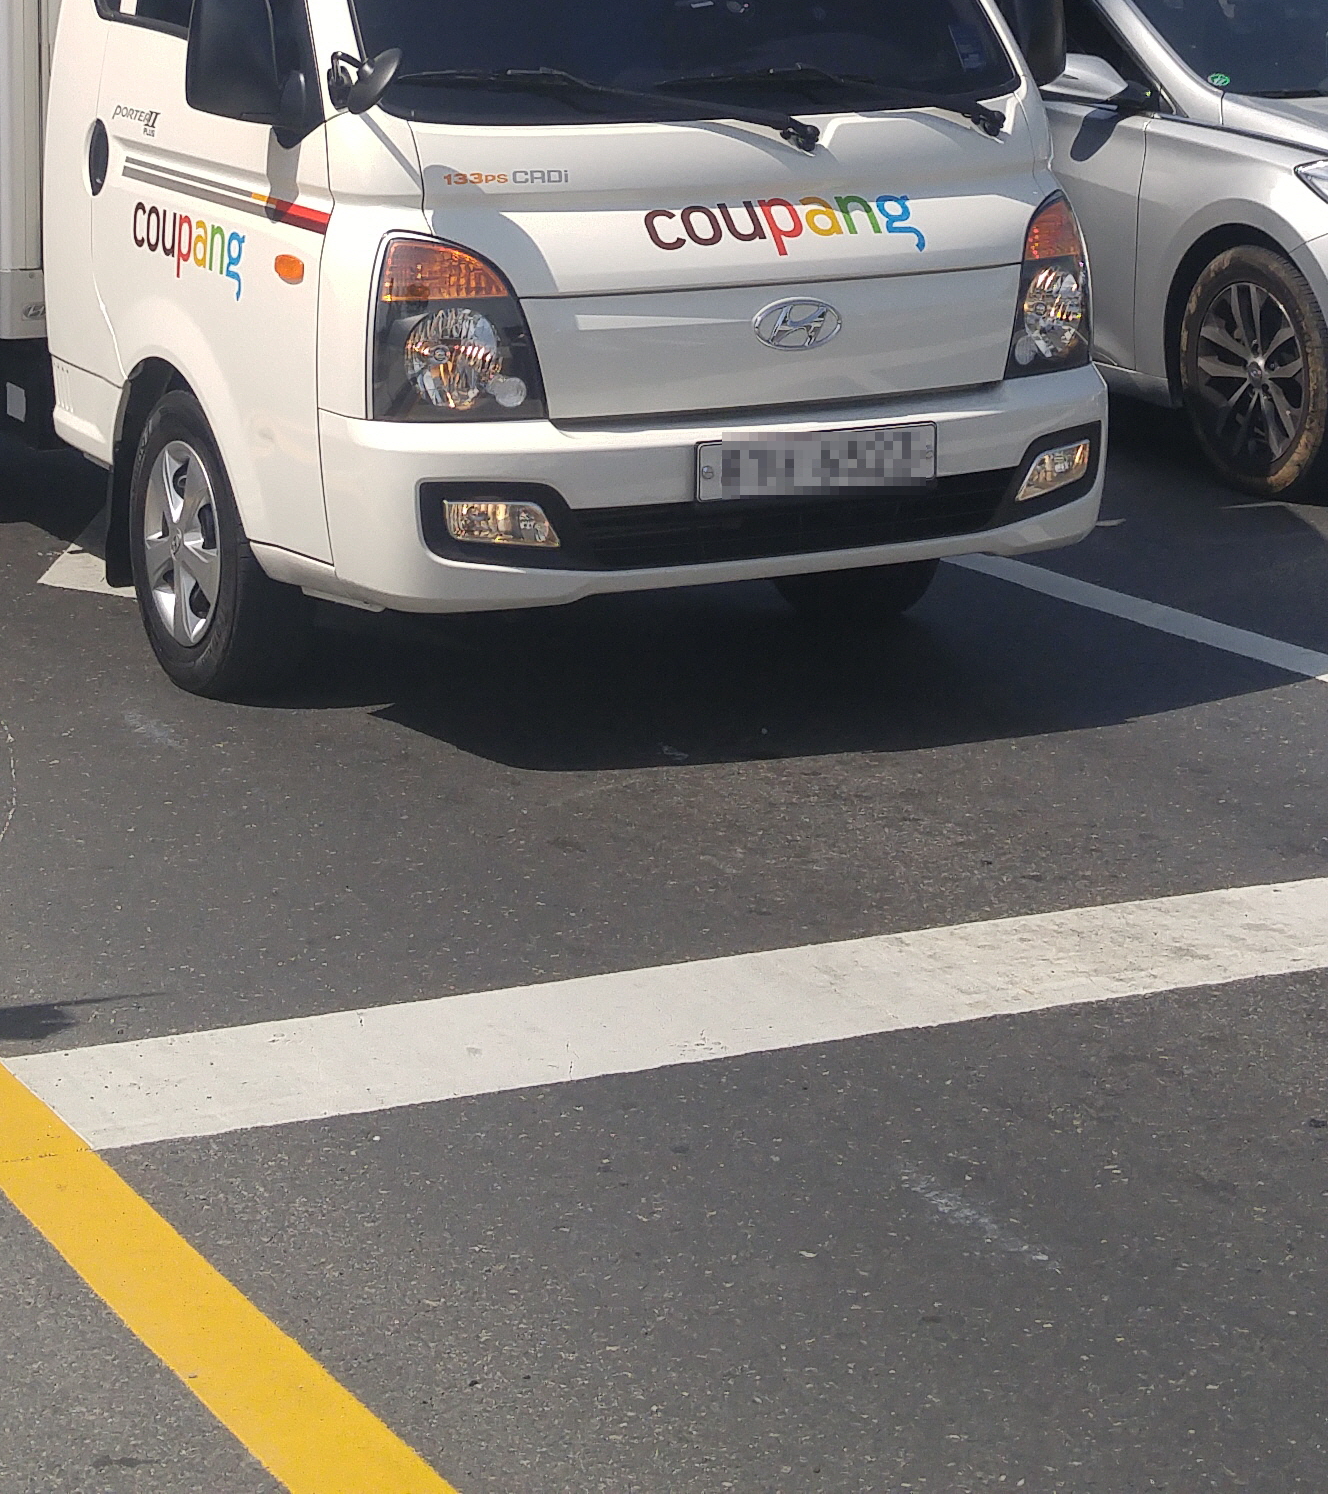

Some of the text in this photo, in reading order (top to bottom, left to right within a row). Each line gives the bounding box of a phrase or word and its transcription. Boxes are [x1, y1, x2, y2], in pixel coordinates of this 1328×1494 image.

[443, 168, 570, 187] 133PS CRDi
[132, 200, 245, 301] coupang
[643, 194, 926, 255] coupang
